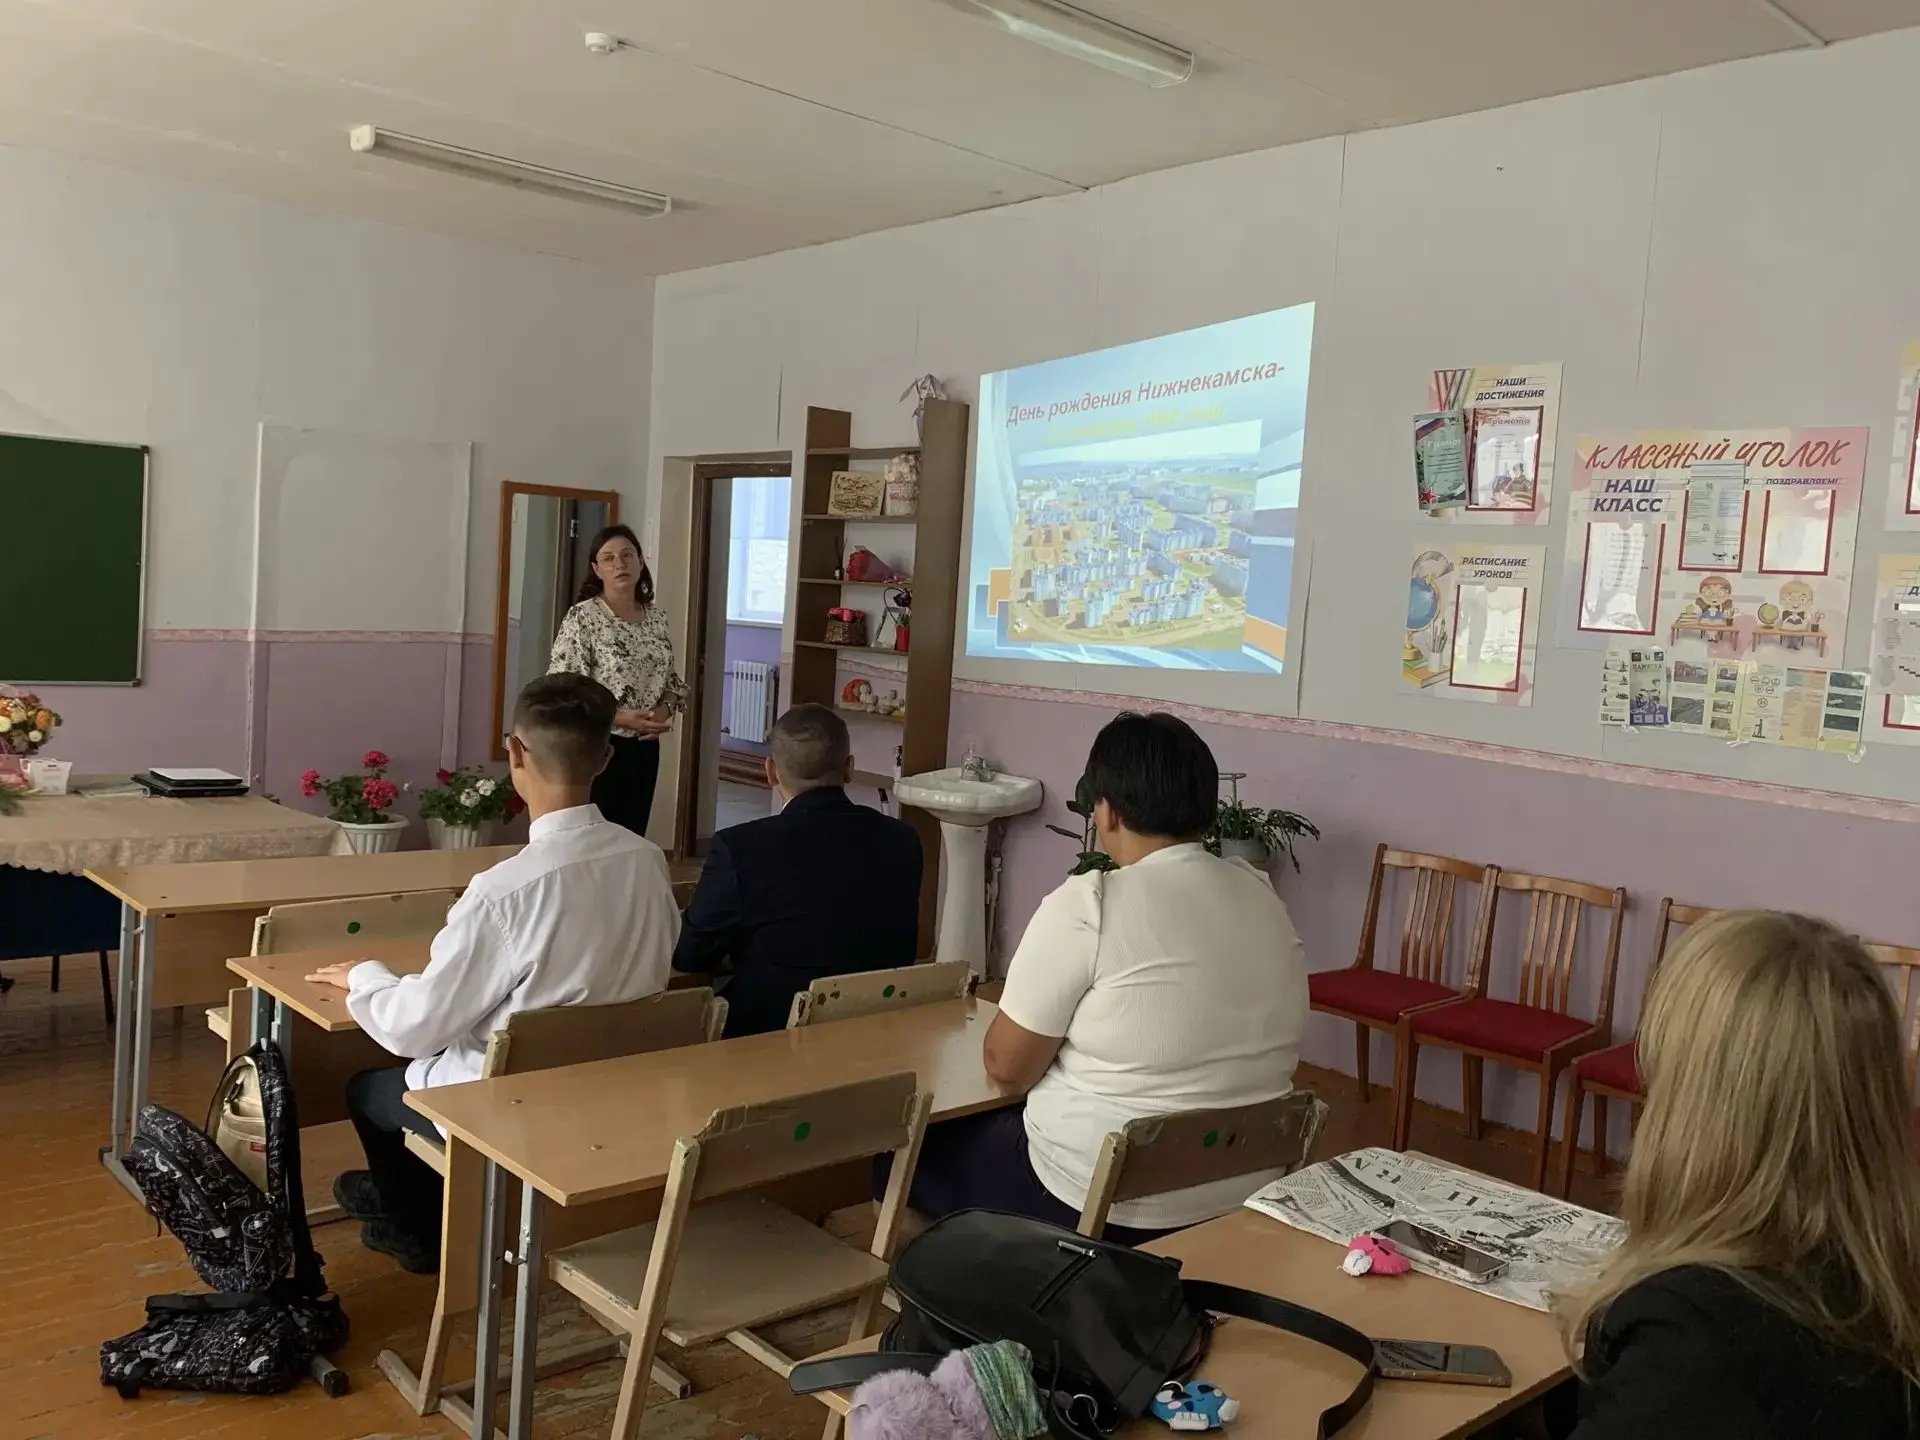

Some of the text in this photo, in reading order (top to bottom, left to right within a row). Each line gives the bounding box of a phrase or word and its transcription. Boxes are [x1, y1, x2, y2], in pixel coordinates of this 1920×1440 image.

[1495, 377, 1527, 387] НАШИ
[1006, 404, 1045, 427] День
[1048, 389, 1132, 422] рождения
[1137, 361, 1286, 402] Нижнекамска-
[1475, 389, 1545, 402] ДОСТИЖЕНИЯ
[1585, 437, 1850, 470] КЛАССНЫЙ УГОЛОК
[1604, 478, 1656, 493] НАШ
[1593, 497, 1664, 513] КЛАСС
[1462, 557, 1528, 567] РАСПИСАНИЕ
[1472, 569, 1513, 579] УРОКОВ
